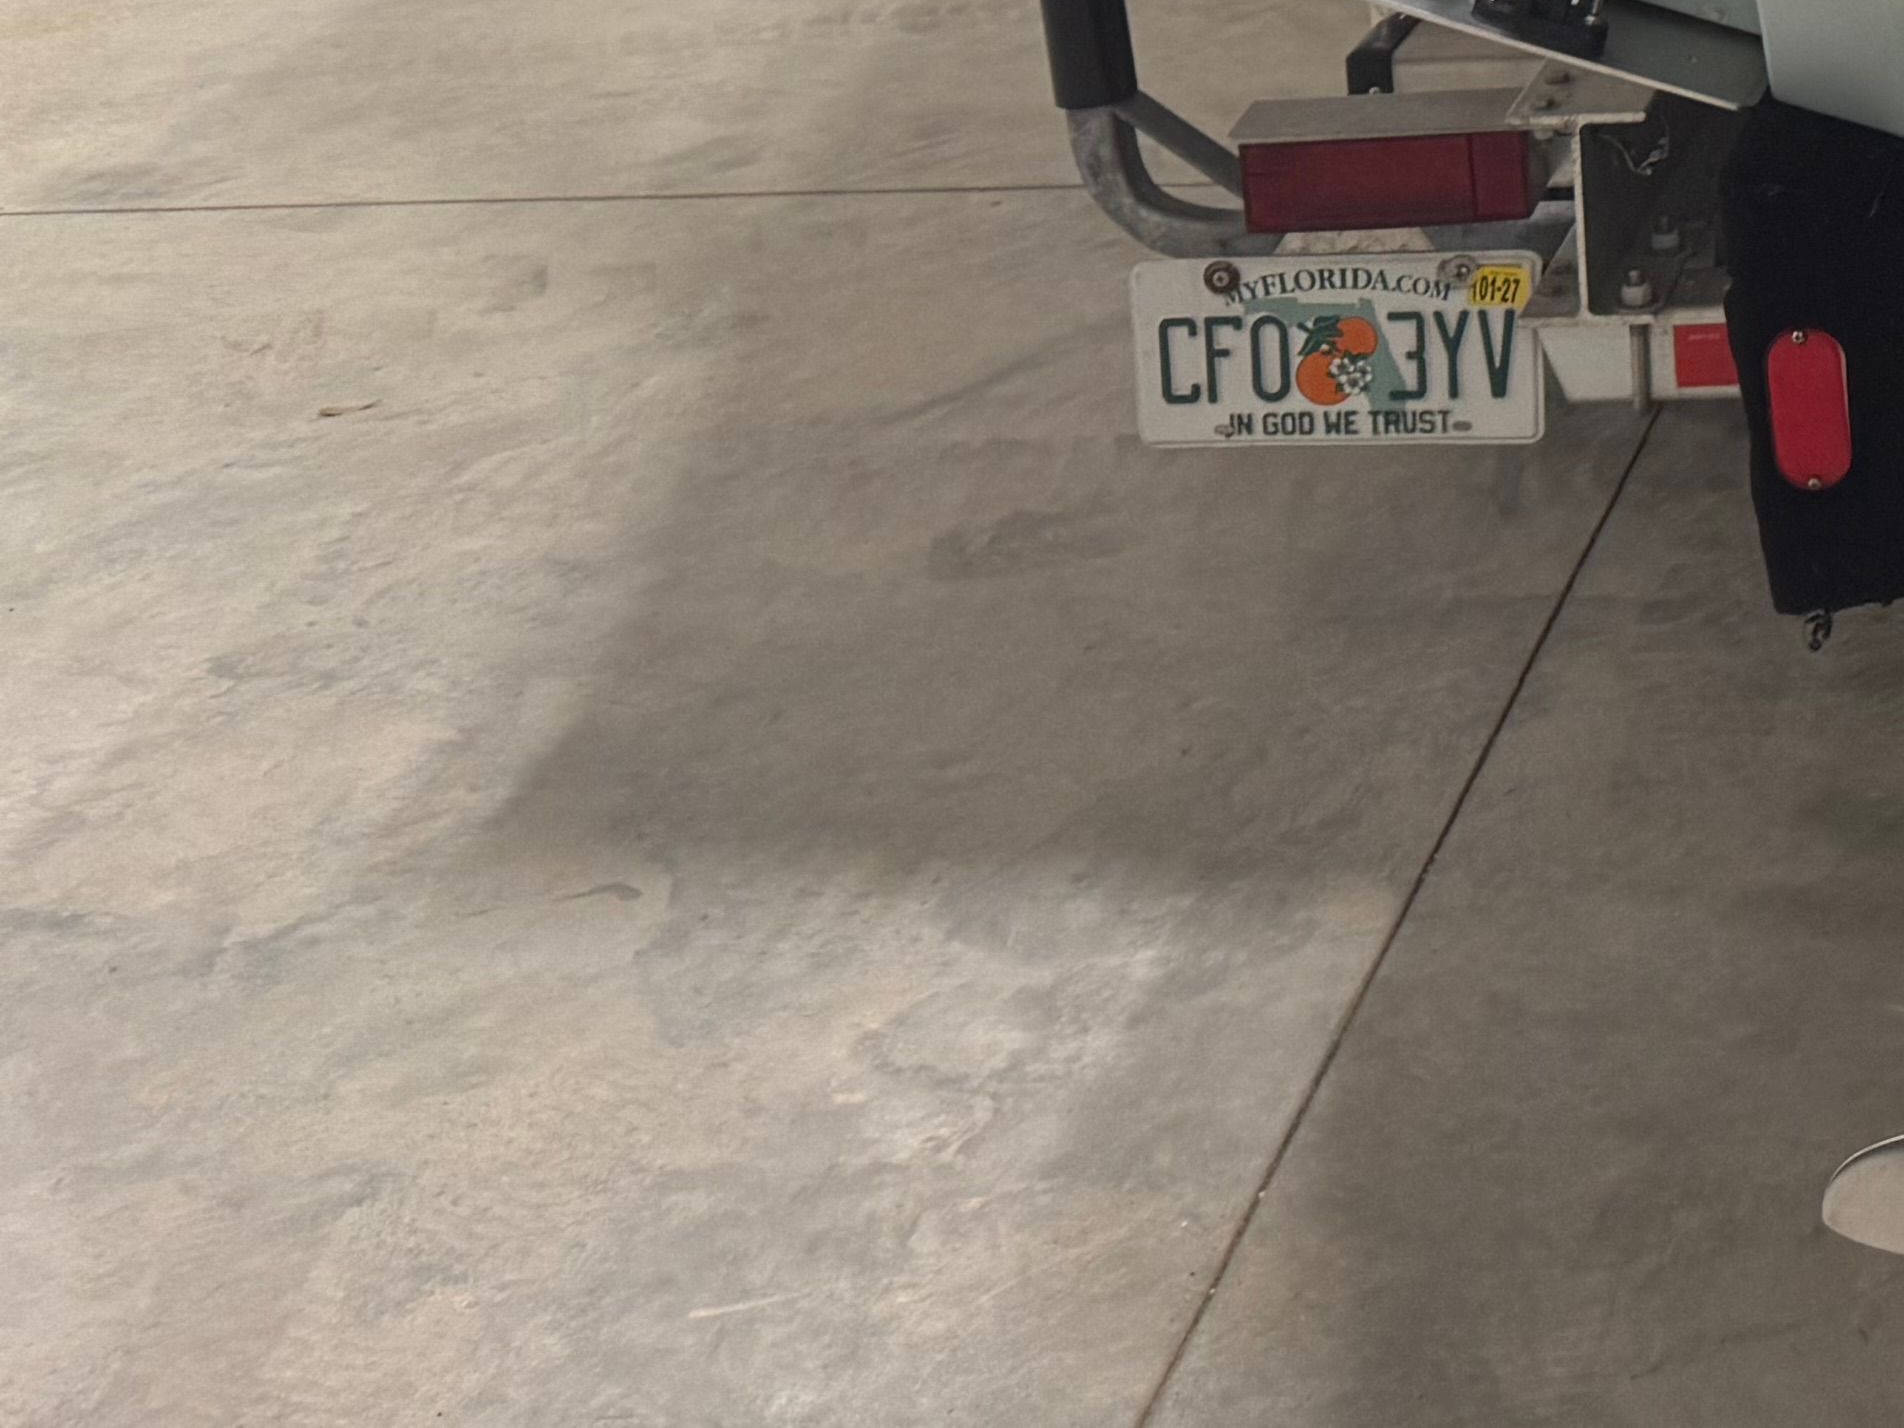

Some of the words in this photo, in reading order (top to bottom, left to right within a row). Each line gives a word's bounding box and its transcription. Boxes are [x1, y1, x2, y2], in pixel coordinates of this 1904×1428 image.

[1228, 414, 1254, 437] IN
[1262, 412, 1315, 436] GOD
[1323, 411, 1357, 435] WE
[1367, 410, 1454, 435] TRUST
